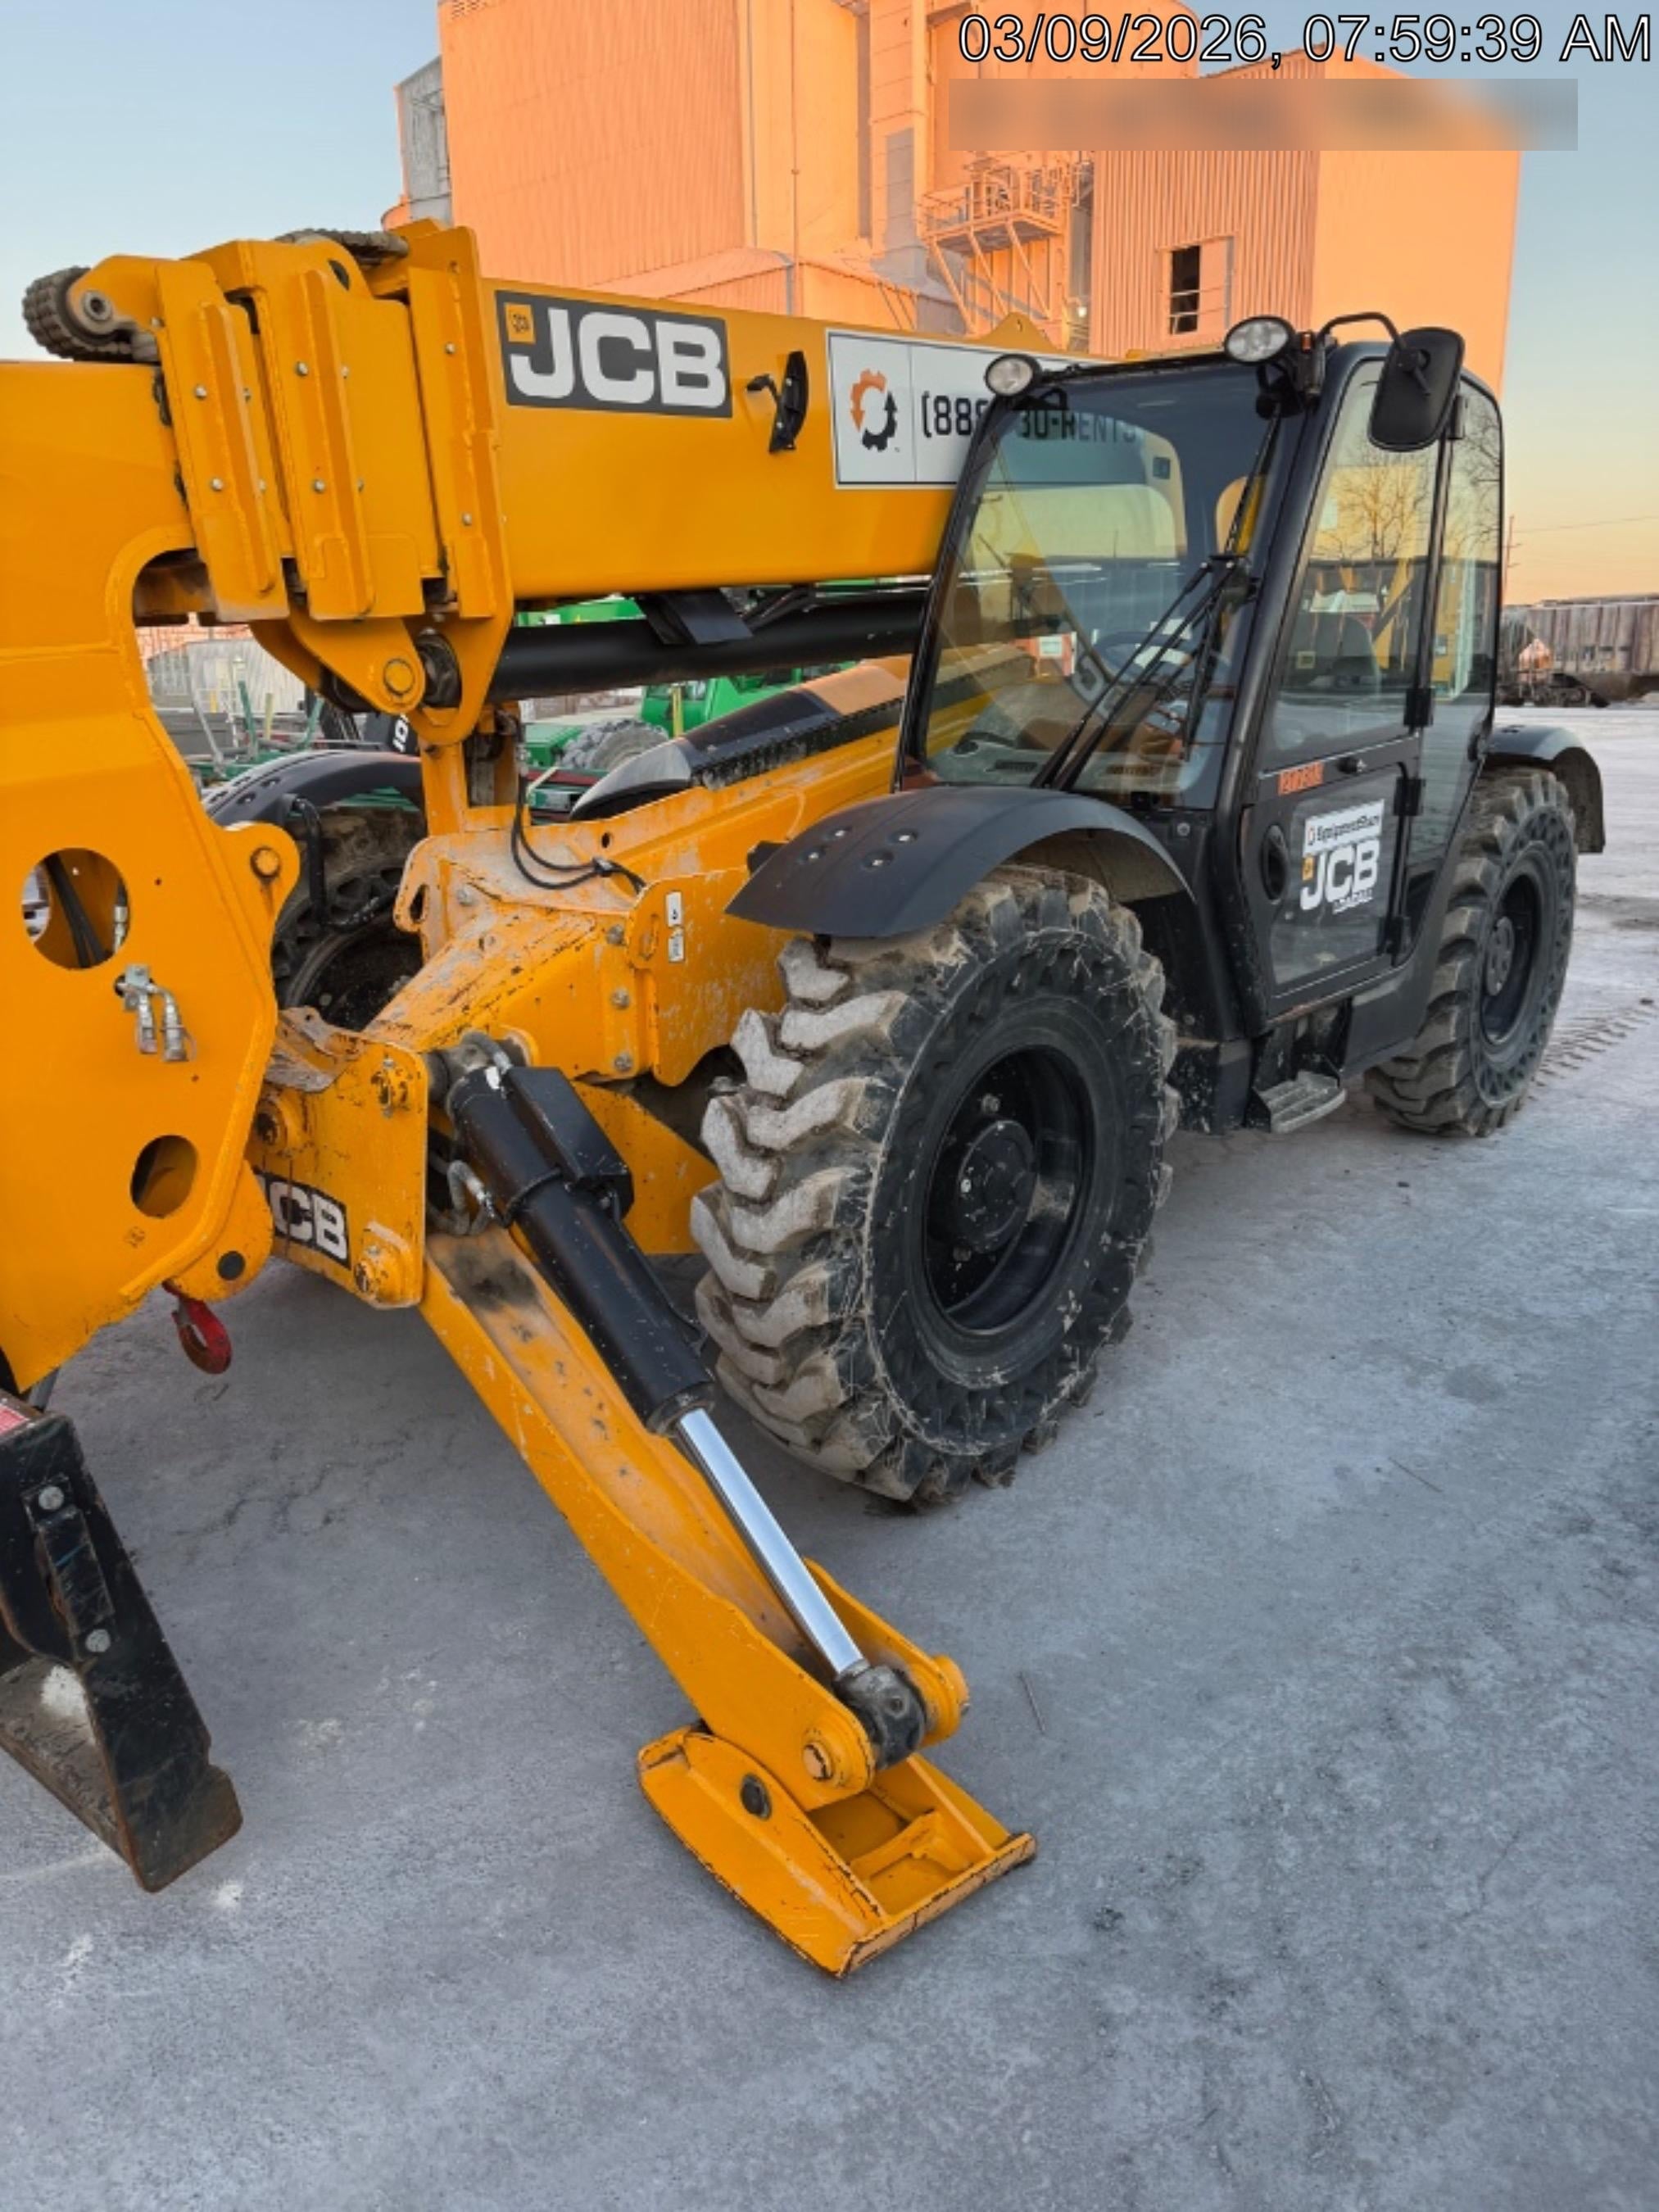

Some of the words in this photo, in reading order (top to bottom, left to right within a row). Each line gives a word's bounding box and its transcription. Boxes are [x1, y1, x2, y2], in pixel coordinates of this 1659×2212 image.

[510, 306, 727, 409] JCB
[1300, 839, 1380, 911] JCB
[256, 1175, 348, 1260] CB
